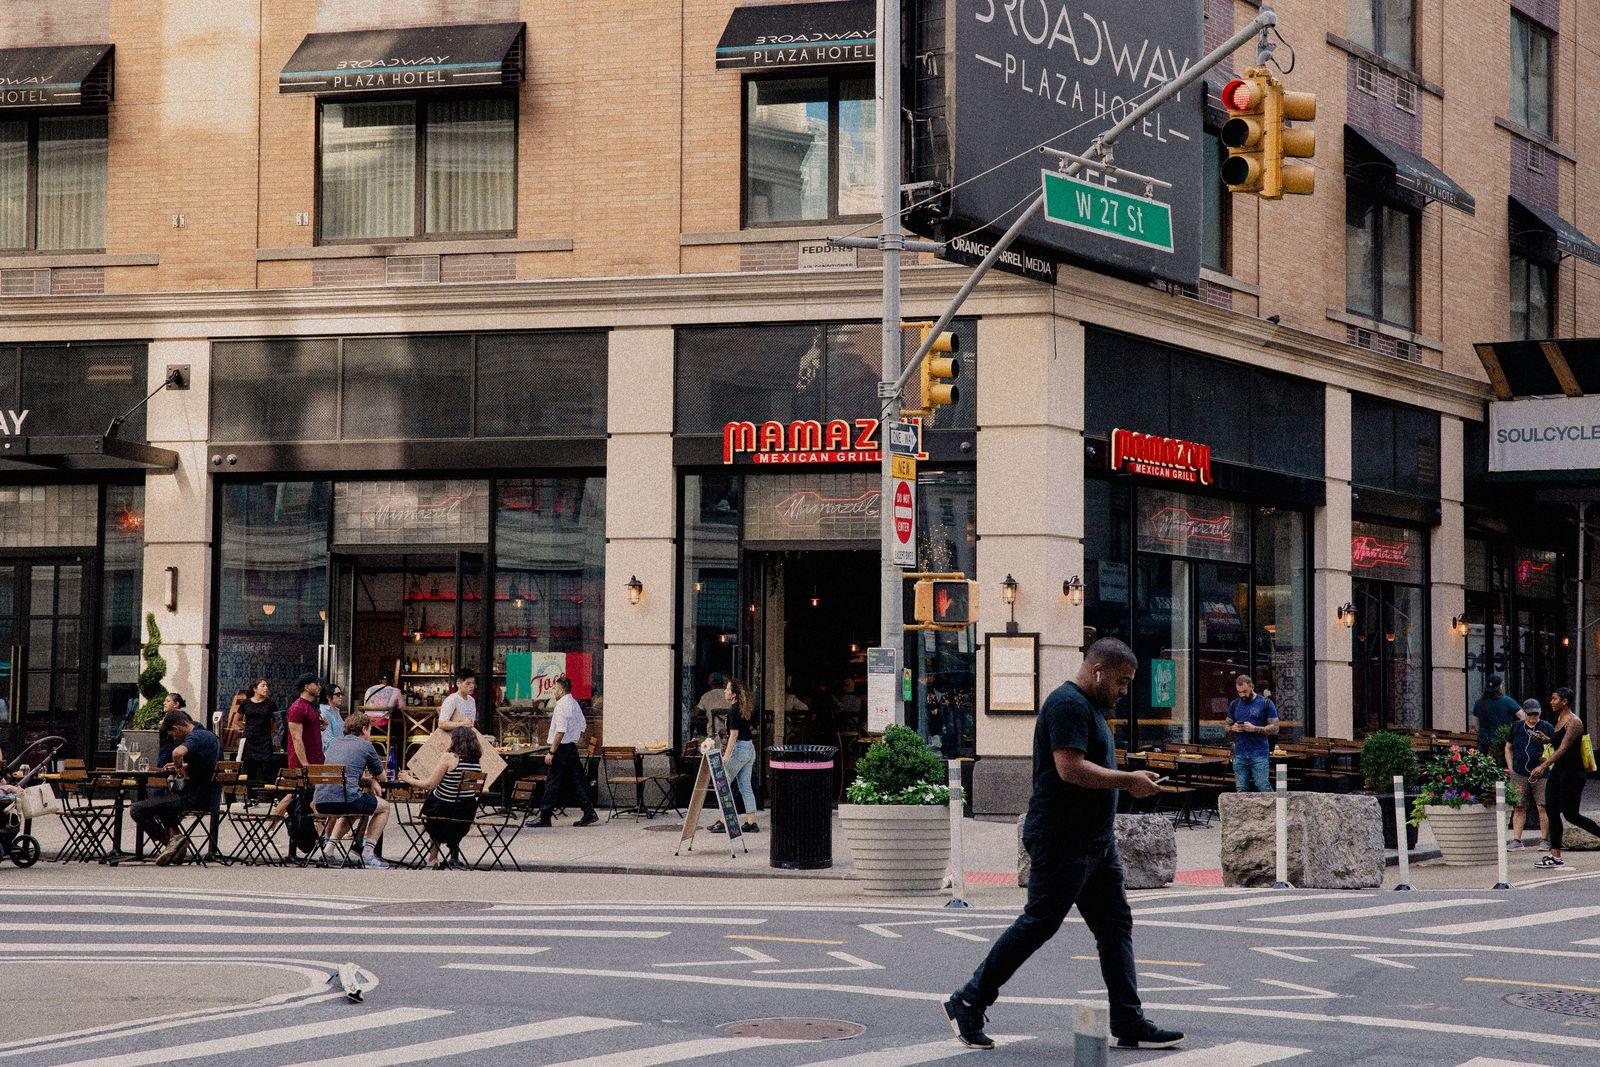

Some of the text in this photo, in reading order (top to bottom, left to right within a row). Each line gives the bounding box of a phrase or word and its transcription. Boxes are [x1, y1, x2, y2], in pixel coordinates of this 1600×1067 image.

[755, 29, 876, 45] BROADWAY
[336, 56, 450, 69] BROADWAY
[753, 46, 874, 63] PLAZA HOTEL
[334, 71, 446, 88] PLAZA HOTEL
[1005, 52, 1085, 112] PLAZA
[1438, 188, 1458, 205] HOTEL
[1075, 190, 1144, 234] W 27 St
[802, 245, 853, 254] FEDDERS
[994, 249, 1022, 267] ARREL
[1025, 256, 1052, 274] MEDIA
[892, 431, 902, 444] ONE
[1497, 424, 1600, 444] SOULCYCLE
[759, 451, 882, 463] MEXICAN GRILL
[1135, 463, 1195, 481] MEXICAN GRILL
[784, 493, 880, 520] Mamazul
[896, 493, 911, 504] DO NOT
[898, 521, 910, 532] ENTER
